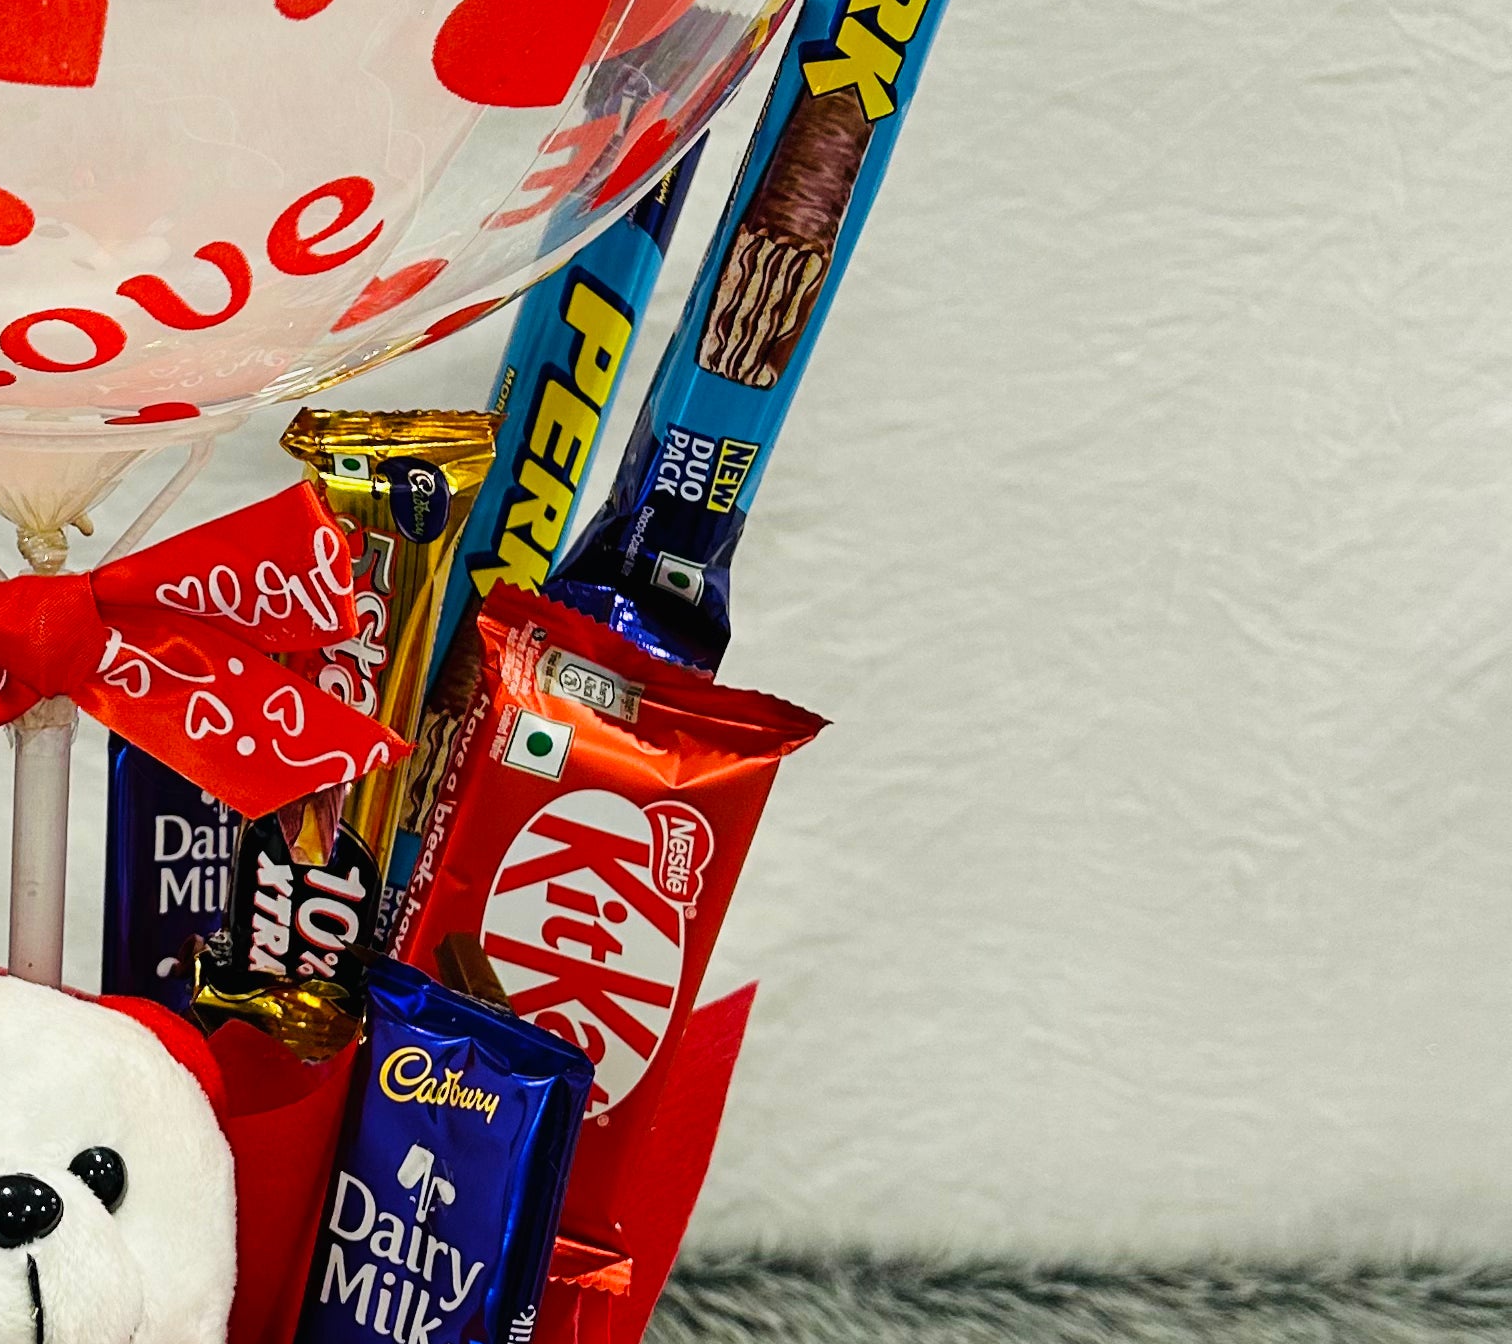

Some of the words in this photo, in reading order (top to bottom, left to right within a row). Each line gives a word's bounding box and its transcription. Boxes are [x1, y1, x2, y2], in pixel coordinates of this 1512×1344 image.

[496, 366, 516, 413] MOR
[470, 281, 634, 599] PERK
[654, 428, 690, 497] PACK
[679, 436, 715, 503] DUO
[710, 441, 756, 510] NEW
[205, 524, 357, 632] love
[457, 692, 491, 768] Have
[445, 776, 458, 793] a
[153, 814, 238, 862] Dai
[158, 865, 230, 915] Mil
[247, 850, 294, 977] XTRA
[294, 866, 367, 979] 10%
[388, 896, 422, 961] have
[378, 1046, 501, 1124] Cadbury
[328, 1169, 486, 1313] Dairy
